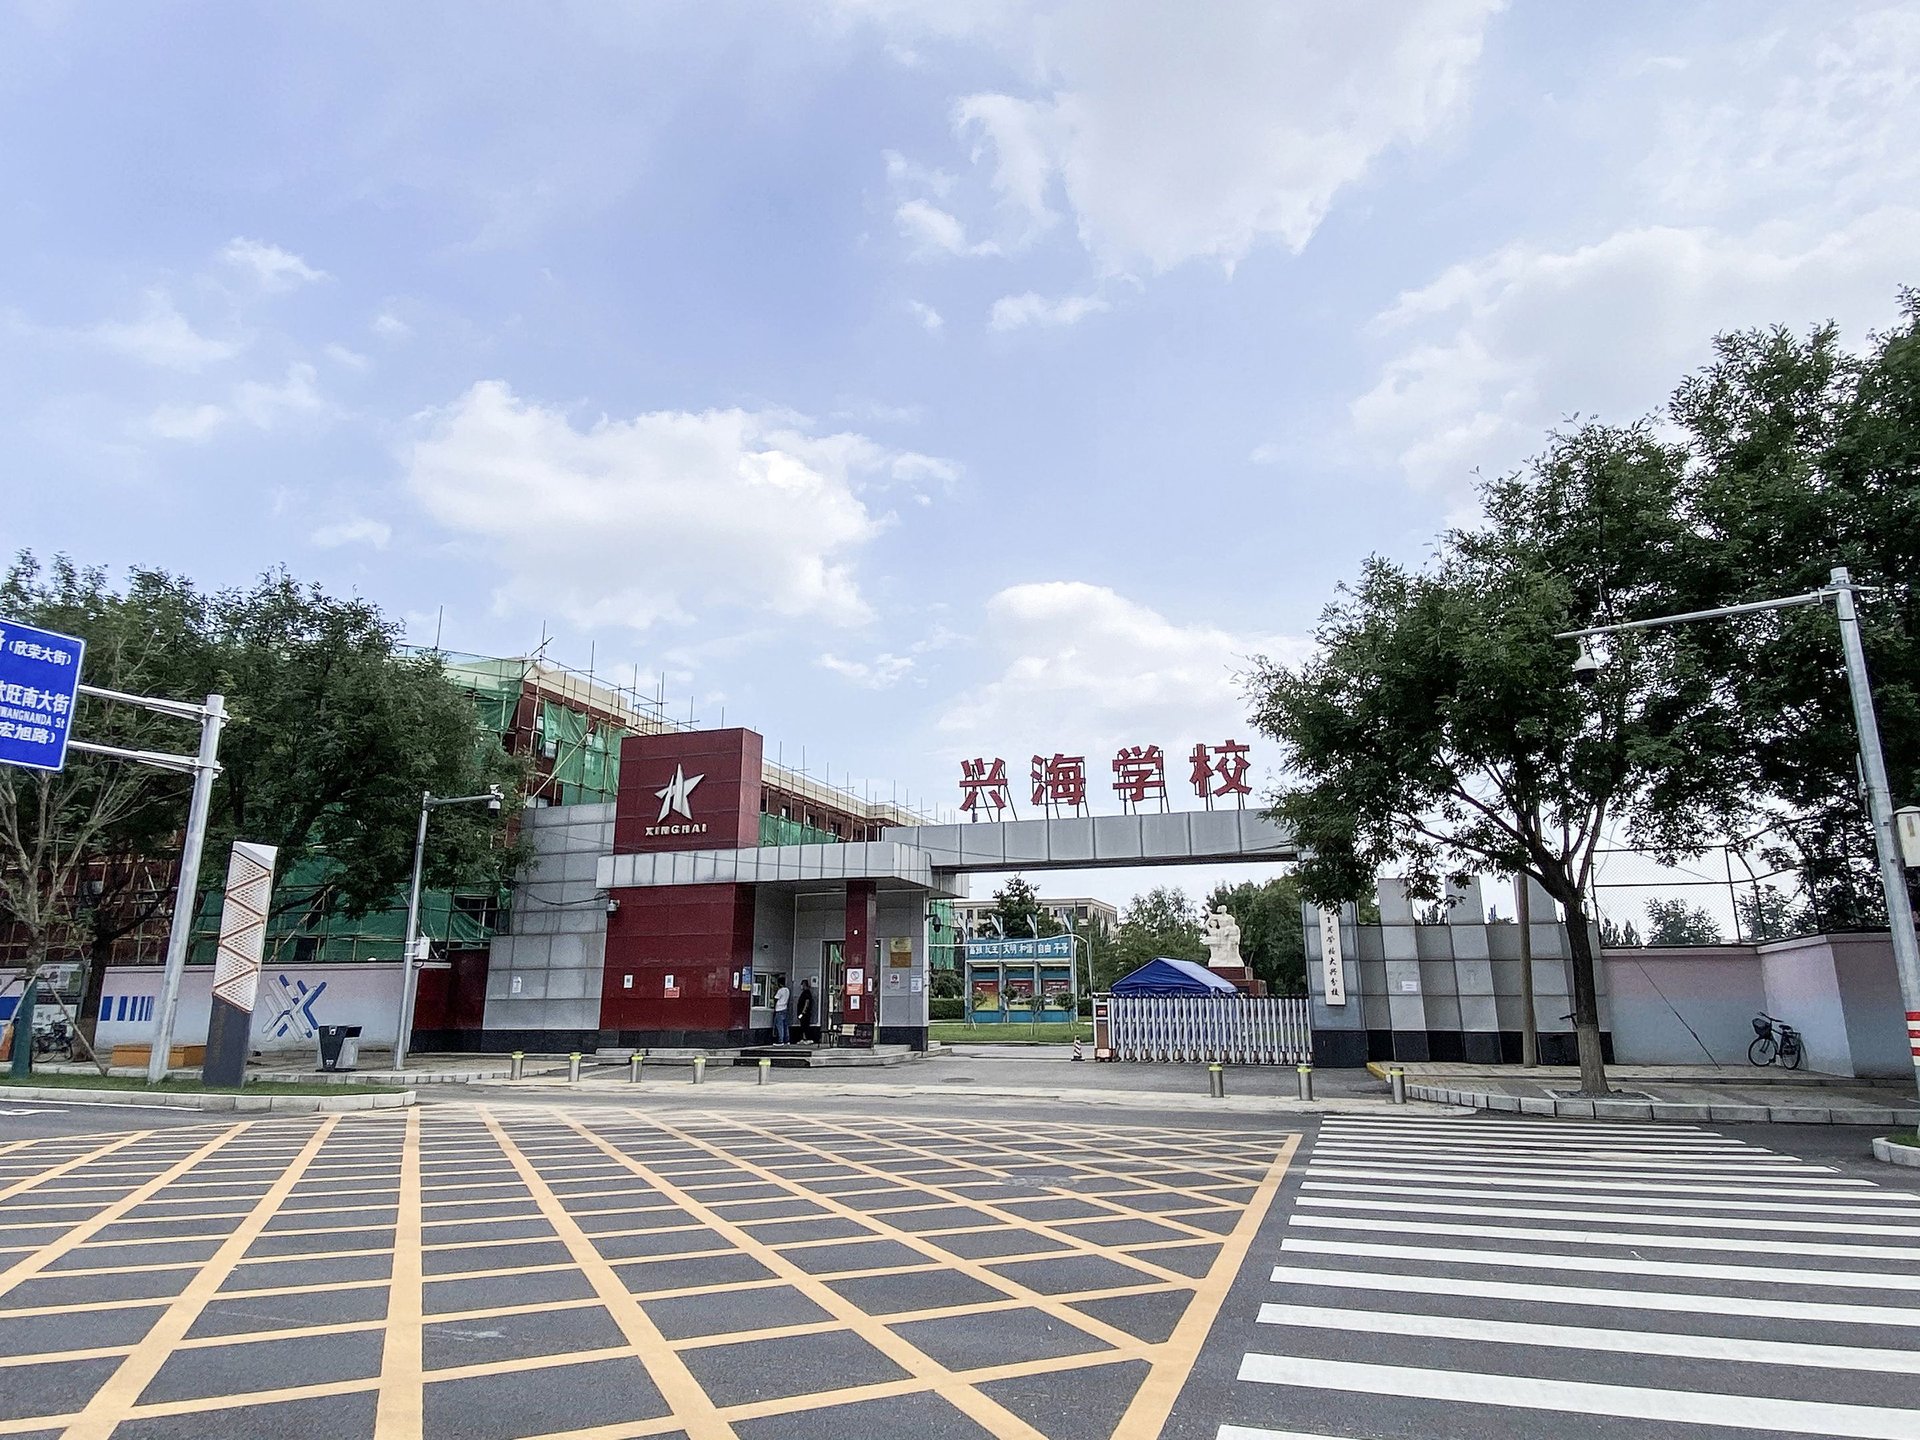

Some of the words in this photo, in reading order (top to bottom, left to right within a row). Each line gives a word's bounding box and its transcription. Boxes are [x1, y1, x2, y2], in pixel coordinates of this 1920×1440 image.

[0, 705, 52, 727] WANGNANDA
[54, 717, 66, 730] St
[959, 739, 1252, 812] 兴海学校
[645, 823, 708, 836] XINGHAI
